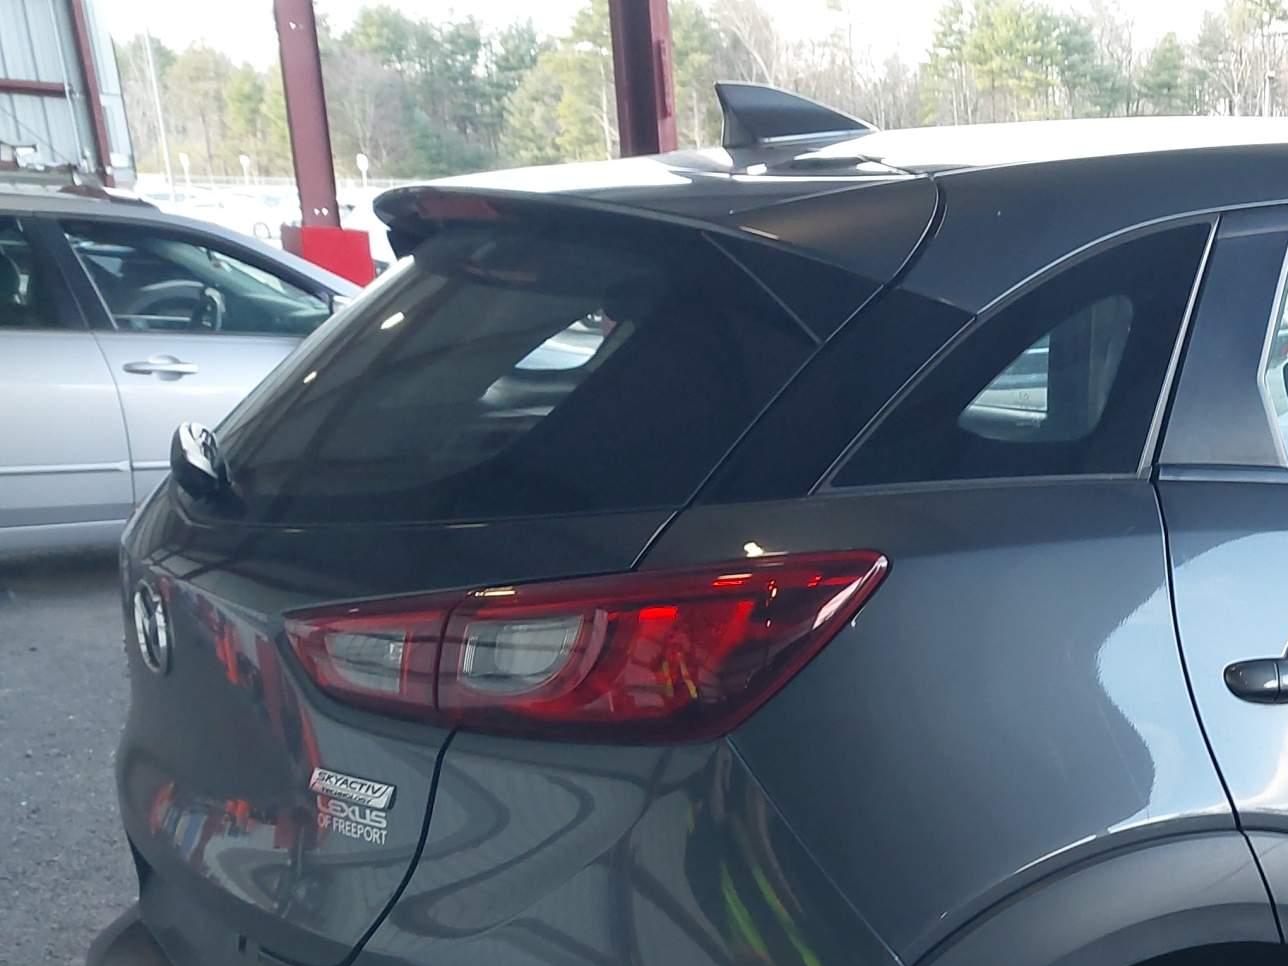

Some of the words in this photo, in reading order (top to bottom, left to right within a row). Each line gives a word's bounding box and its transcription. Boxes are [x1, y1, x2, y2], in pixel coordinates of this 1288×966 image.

[317, 771, 383, 795] SKYACTIV
[317, 795, 387, 828] LEXUS
[317, 813, 332, 829] OF
[333, 818, 388, 845] FREEPORT
